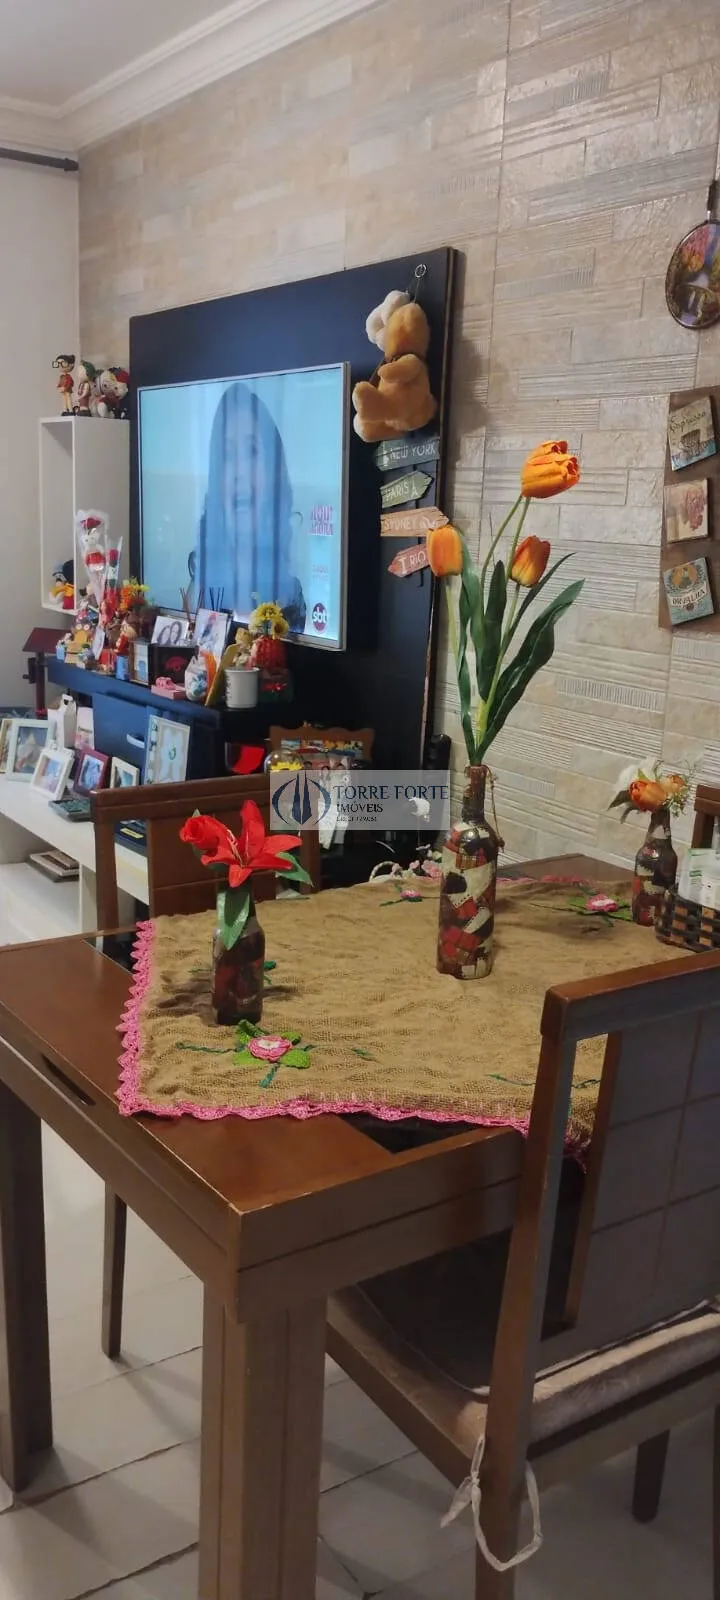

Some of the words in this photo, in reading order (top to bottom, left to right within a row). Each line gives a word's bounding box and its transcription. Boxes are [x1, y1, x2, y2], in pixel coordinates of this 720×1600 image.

[389, 444, 409, 460] NEW
[411, 440, 437, 457] YORK
[384, 480, 409, 501] PARIS
[384, 517, 417, 530] SYDNEY
